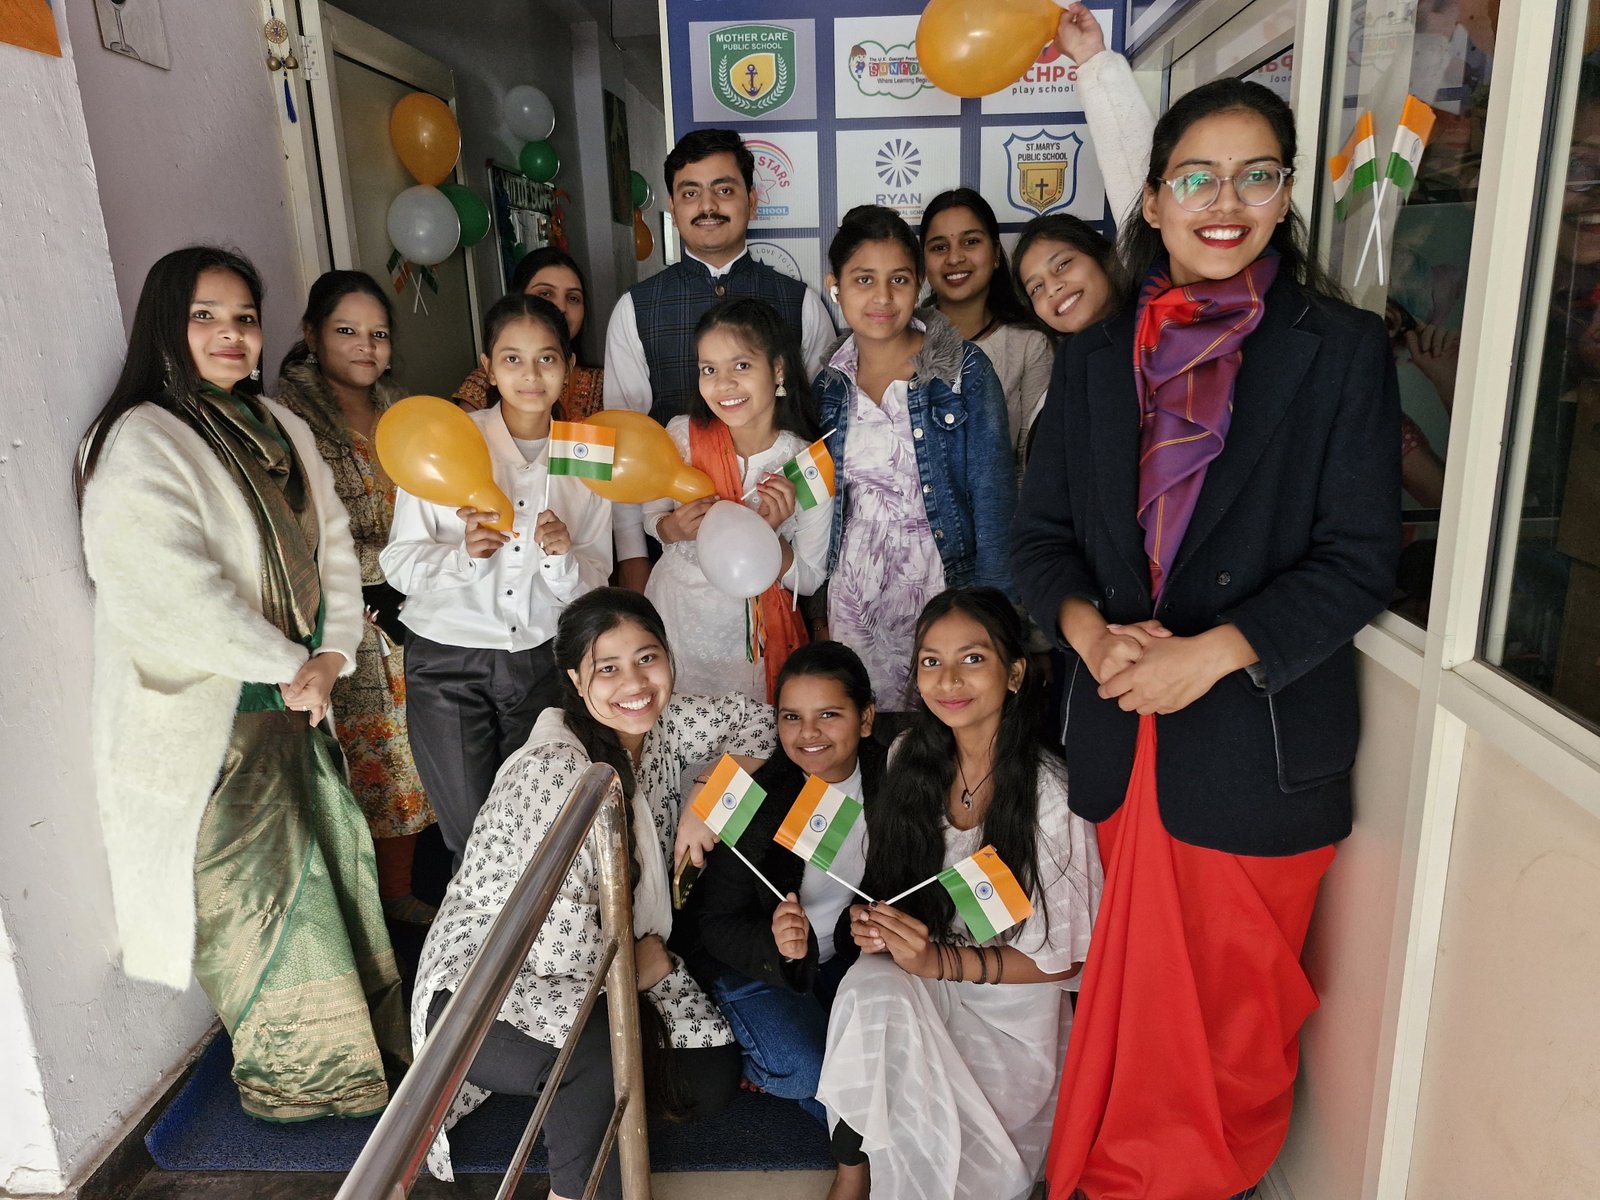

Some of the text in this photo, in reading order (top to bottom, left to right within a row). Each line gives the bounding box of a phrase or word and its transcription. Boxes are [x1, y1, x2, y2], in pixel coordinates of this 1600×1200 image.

[716, 32, 788, 42] MOTHER CARE
[723, 42, 783, 51] PUBLIC SCHOOL
[1012, 84, 1074, 96] play school
[1018, 152, 1068, 161] PUBLIC SCHOOL
[758, 156, 790, 188] STARS
[875, 193, 922, 205] RYAN
[756, 207, 788, 215] CHOOL
[756, 248, 775, 256] LOVE
[778, 254, 788, 264] TO
